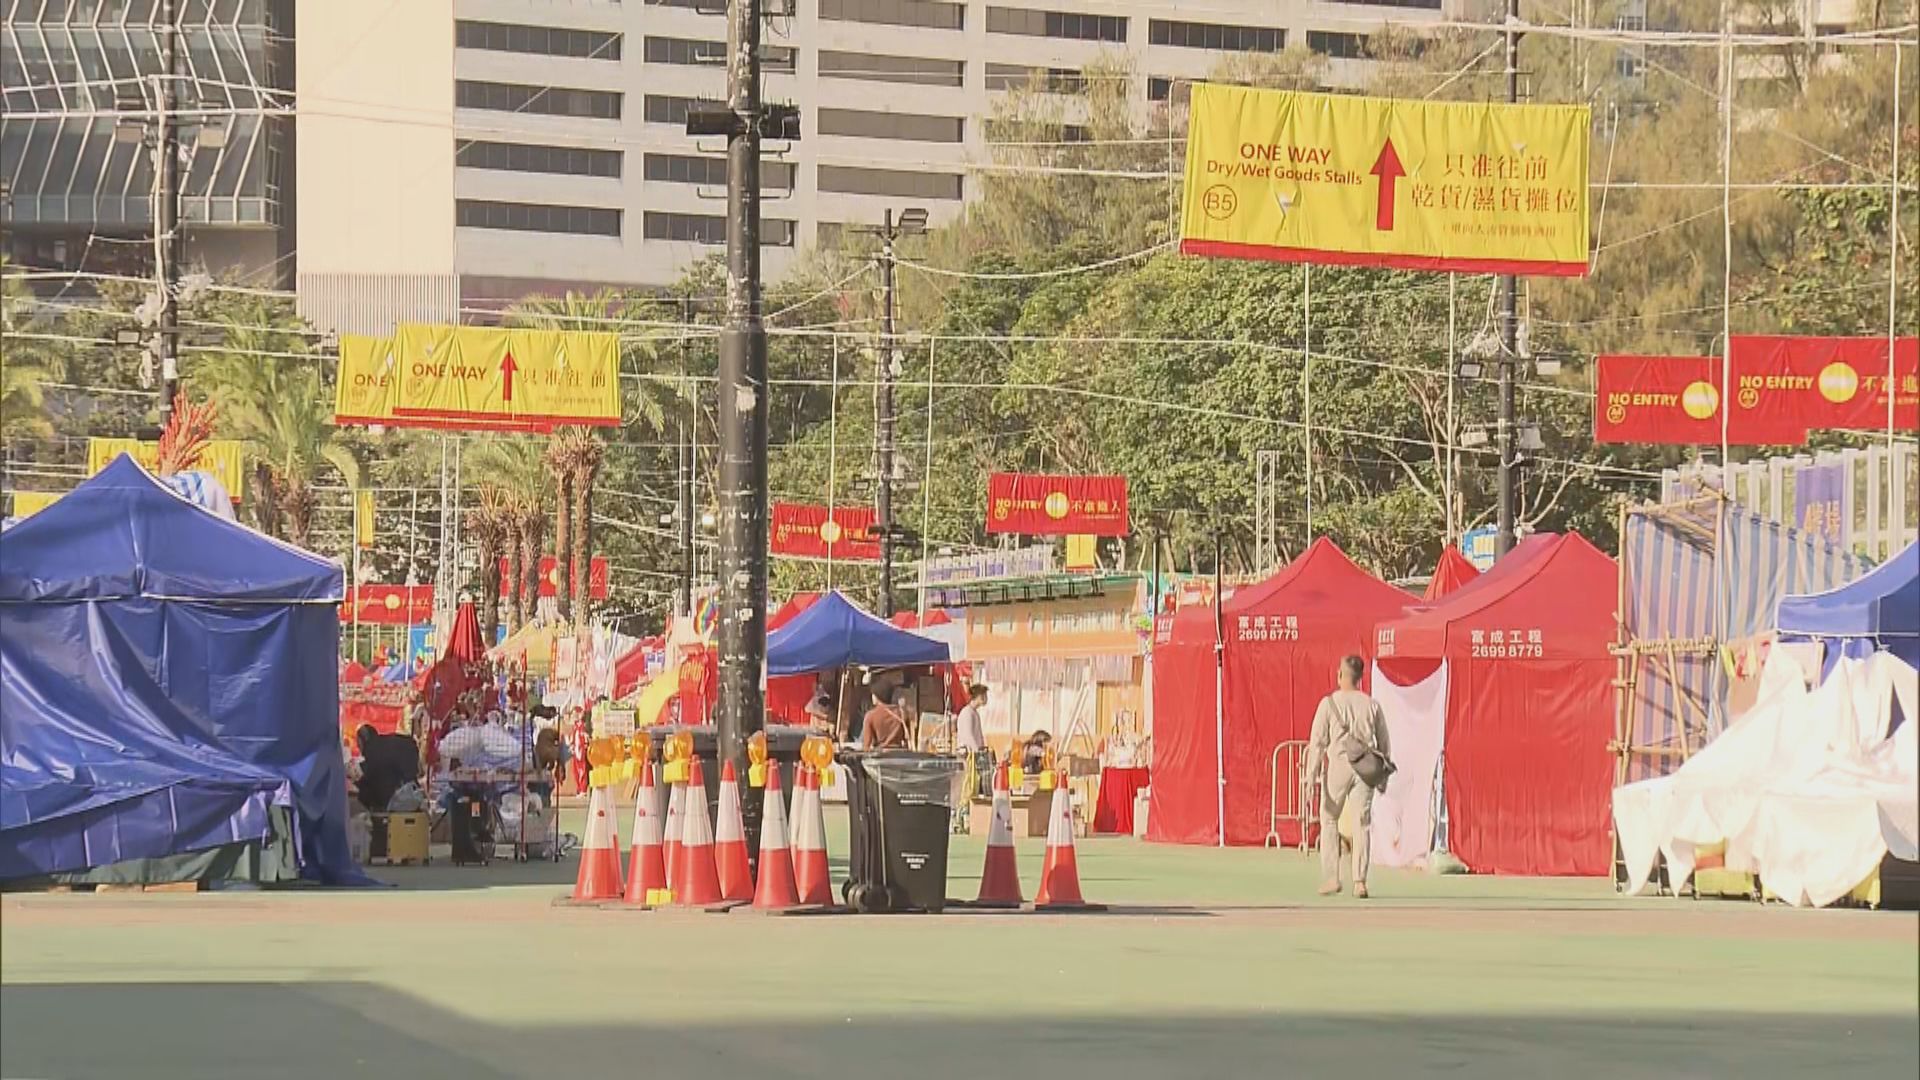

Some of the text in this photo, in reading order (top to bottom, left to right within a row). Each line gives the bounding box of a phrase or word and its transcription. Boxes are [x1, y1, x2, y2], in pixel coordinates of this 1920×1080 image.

[1240, 143, 1331, 165] ONE WAY
[1207, 160, 1362, 185] Dry/Wet Goods Stalls
[1444, 154, 1548, 180] 只准往前
[1206, 191, 1233, 212] B5
[412, 362, 487, 381] ONE WAY
[354, 373, 389, 387] ONE
[1739, 375, 1815, 390] NO ENTRY
[1608, 393, 1678, 407] NO ENTRY
[996, 498, 1012, 509] NO
[1238, 615, 1298, 629] 富成工程
[1238, 629, 1268, 641] 2699
[1471, 629, 1543, 644] 富成工程
[1471, 645, 1543, 658] 2699 8779
